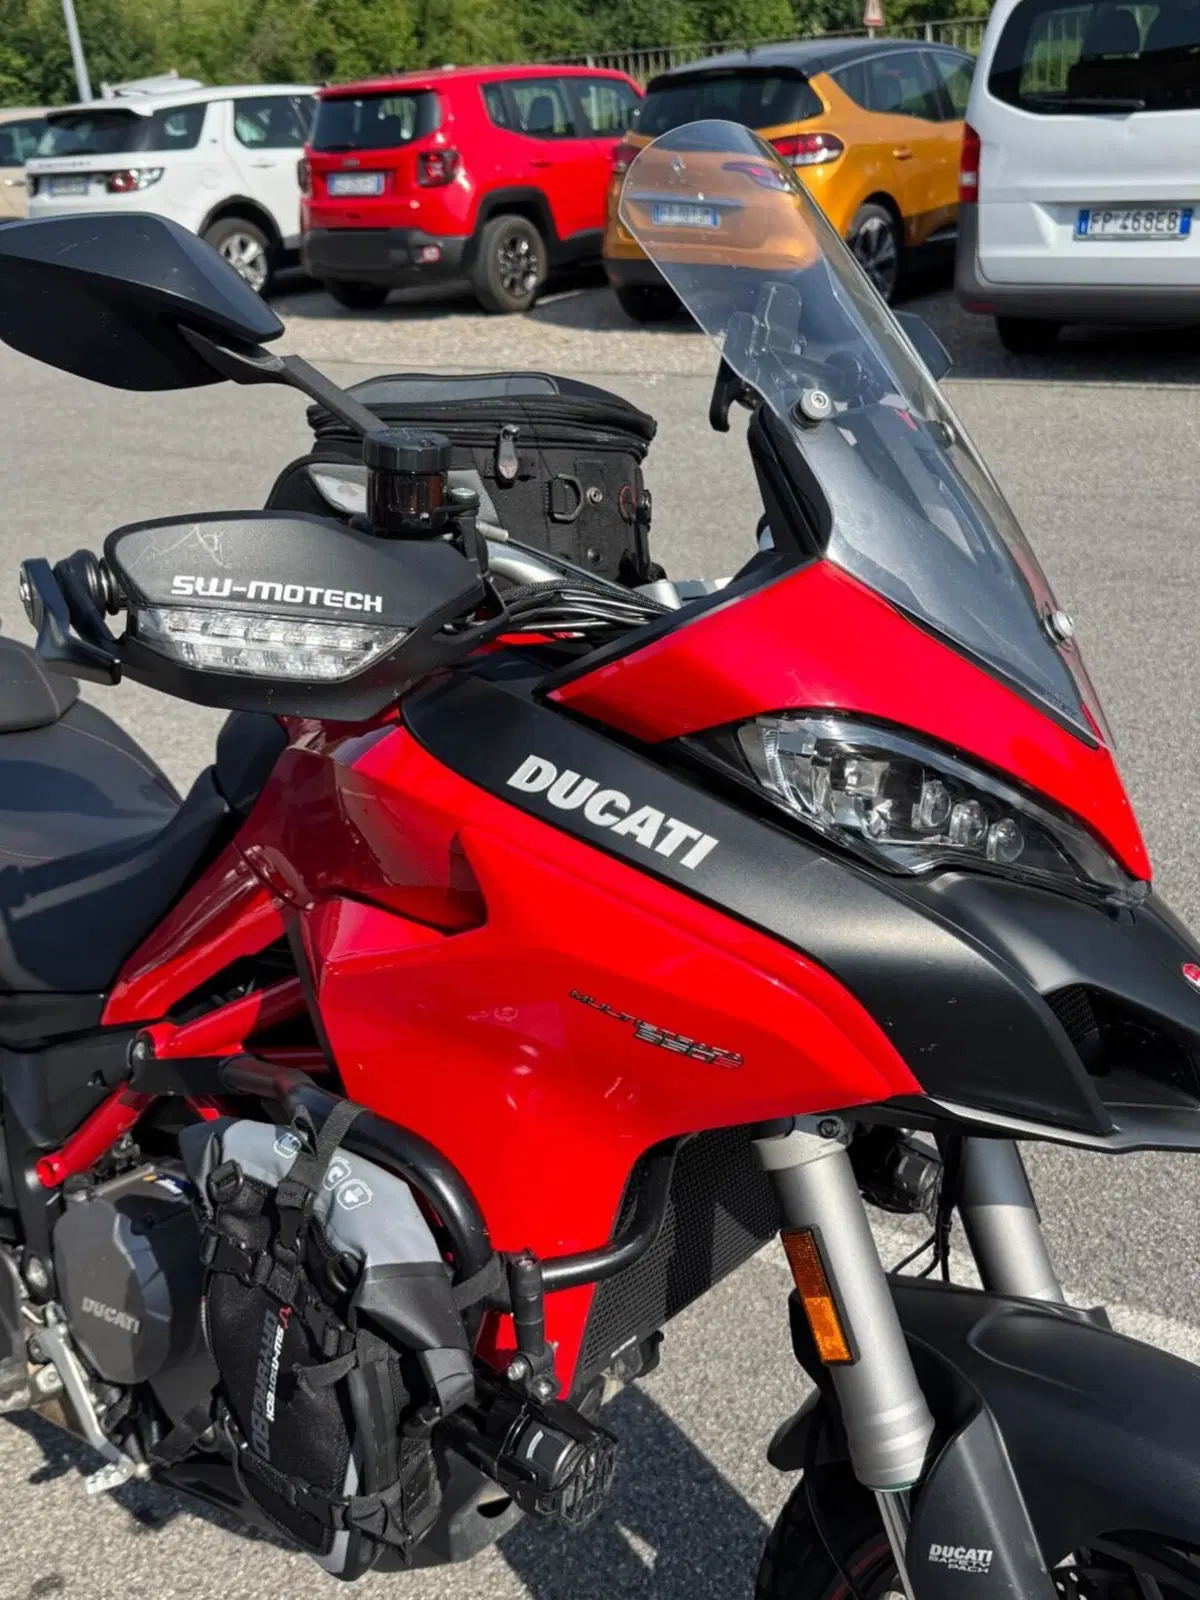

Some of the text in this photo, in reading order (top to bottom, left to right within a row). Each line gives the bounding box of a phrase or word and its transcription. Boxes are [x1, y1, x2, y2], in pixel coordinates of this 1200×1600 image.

[171, 575, 383, 613] SW-MOTECH
[506, 754, 719, 871] DUCATI
[82, 1296, 140, 1334] DUCATI
[928, 1555, 991, 1568] SAFETY
[929, 1543, 993, 1562] DUCATI
